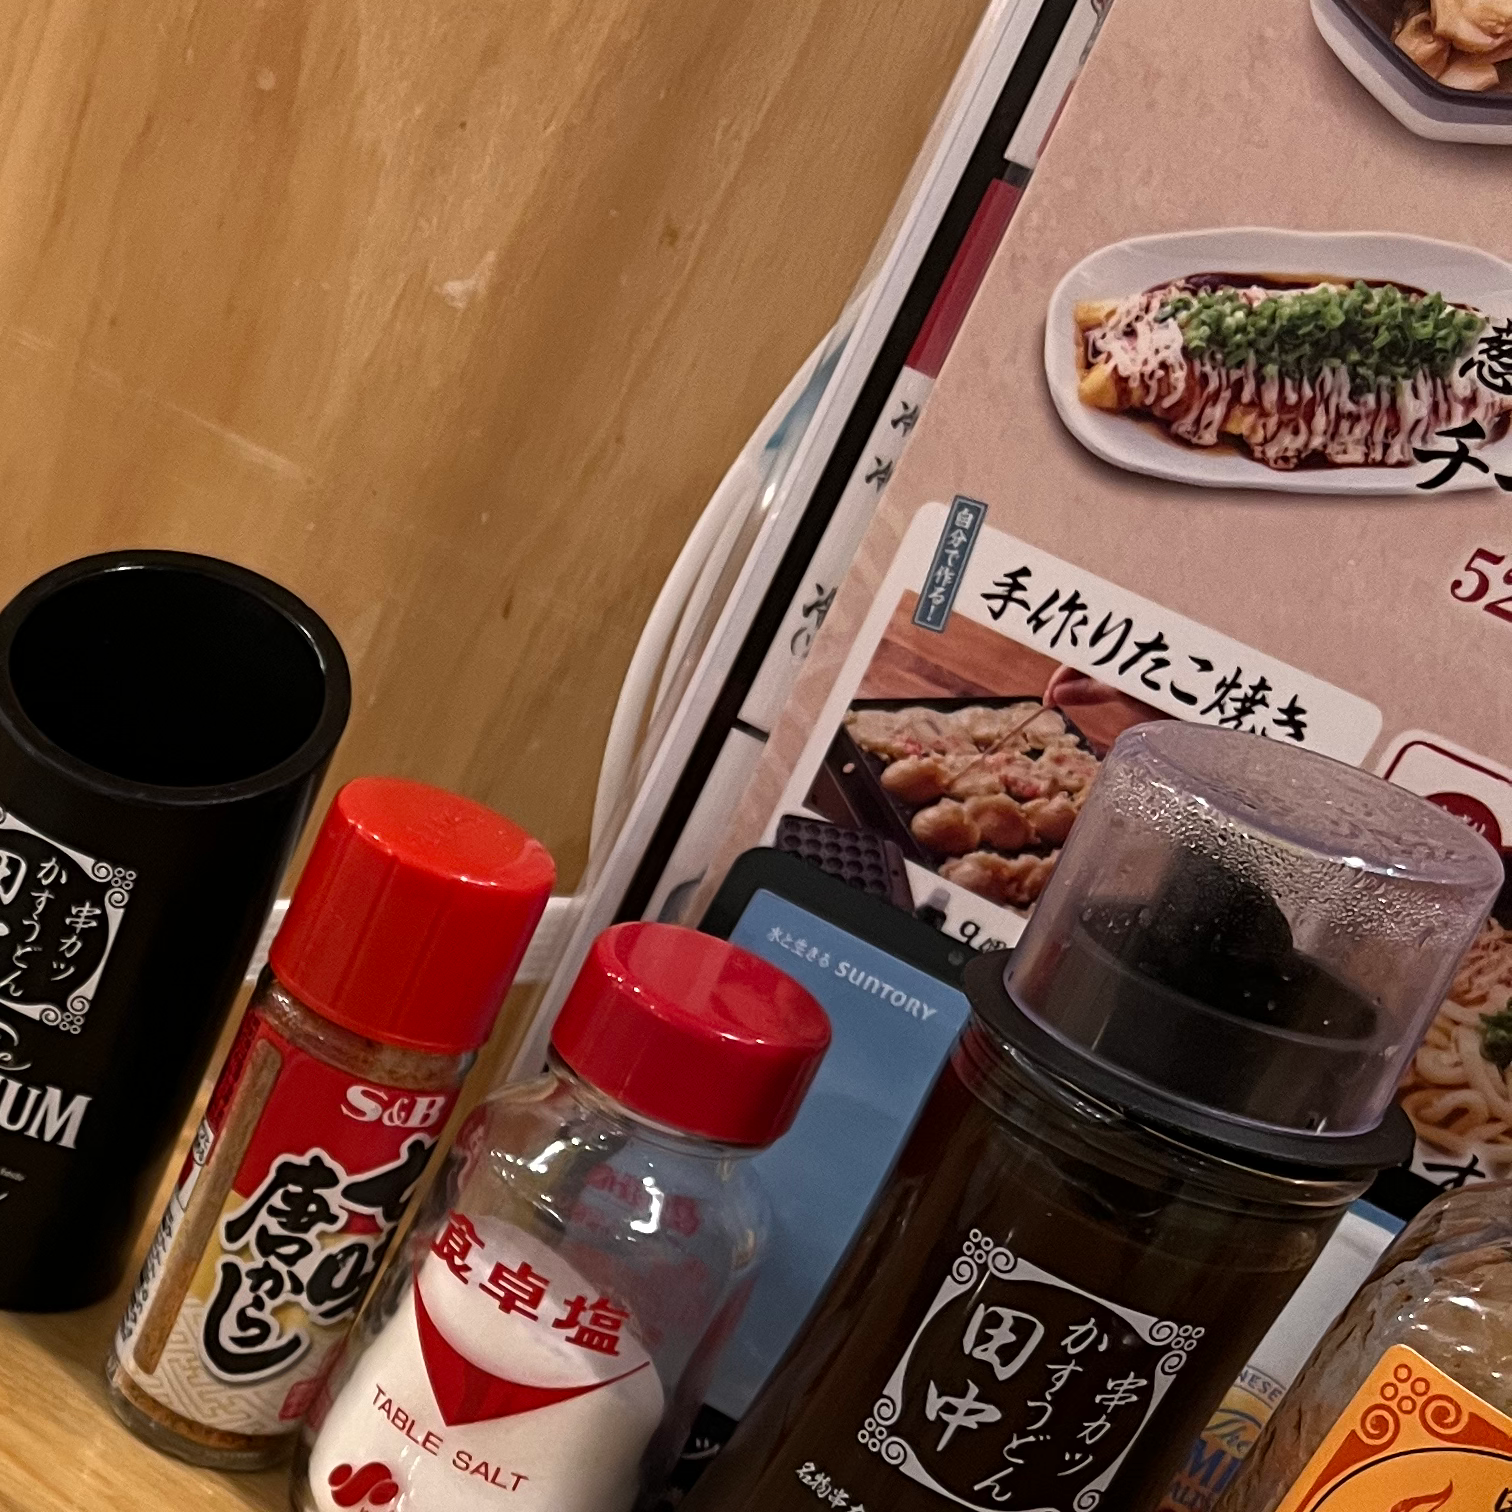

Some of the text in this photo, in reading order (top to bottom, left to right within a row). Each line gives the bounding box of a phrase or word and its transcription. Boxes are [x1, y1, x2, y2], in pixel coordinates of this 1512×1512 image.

[927, 507, 975, 622] 自分で作る!
[979, 565, 1308, 742] 手作りたこ焼き
[50, 901, 102, 982] 串カツ
[767, 926, 830, 968] 水と生きる
[341, 1085, 445, 1127] S&B
[430, 1209, 629, 1356] 食卓塩
[925, 1303, 1045, 1451] 田中
[974, 1318, 1108, 1501] かすうどん
[1058, 1372, 1147, 1477] 串カツ
[373, 1385, 529, 1492] TABLE SALT
